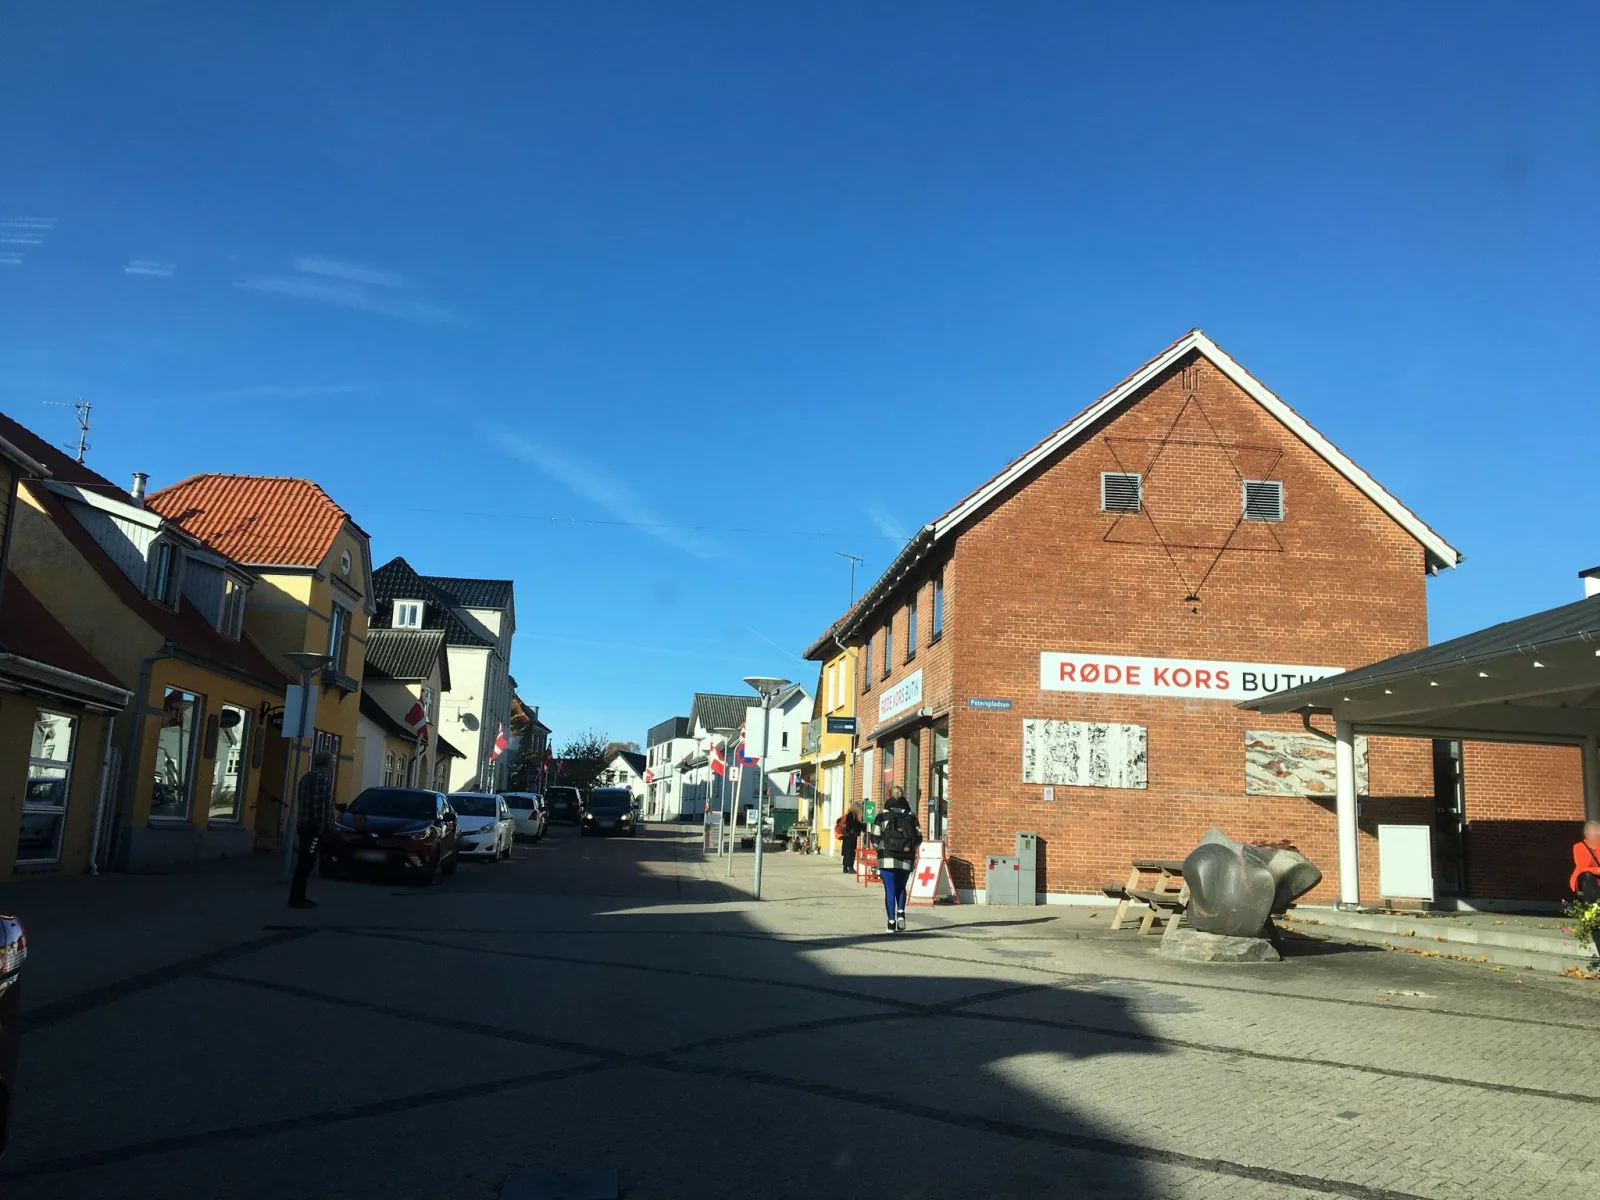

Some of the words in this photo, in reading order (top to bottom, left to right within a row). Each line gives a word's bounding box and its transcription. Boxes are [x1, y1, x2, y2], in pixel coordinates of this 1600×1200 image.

[1059, 662, 1141, 685] RØDE
[1154, 667, 1230, 690] KORS
[970, 699, 1010, 709] Peterspladsen
